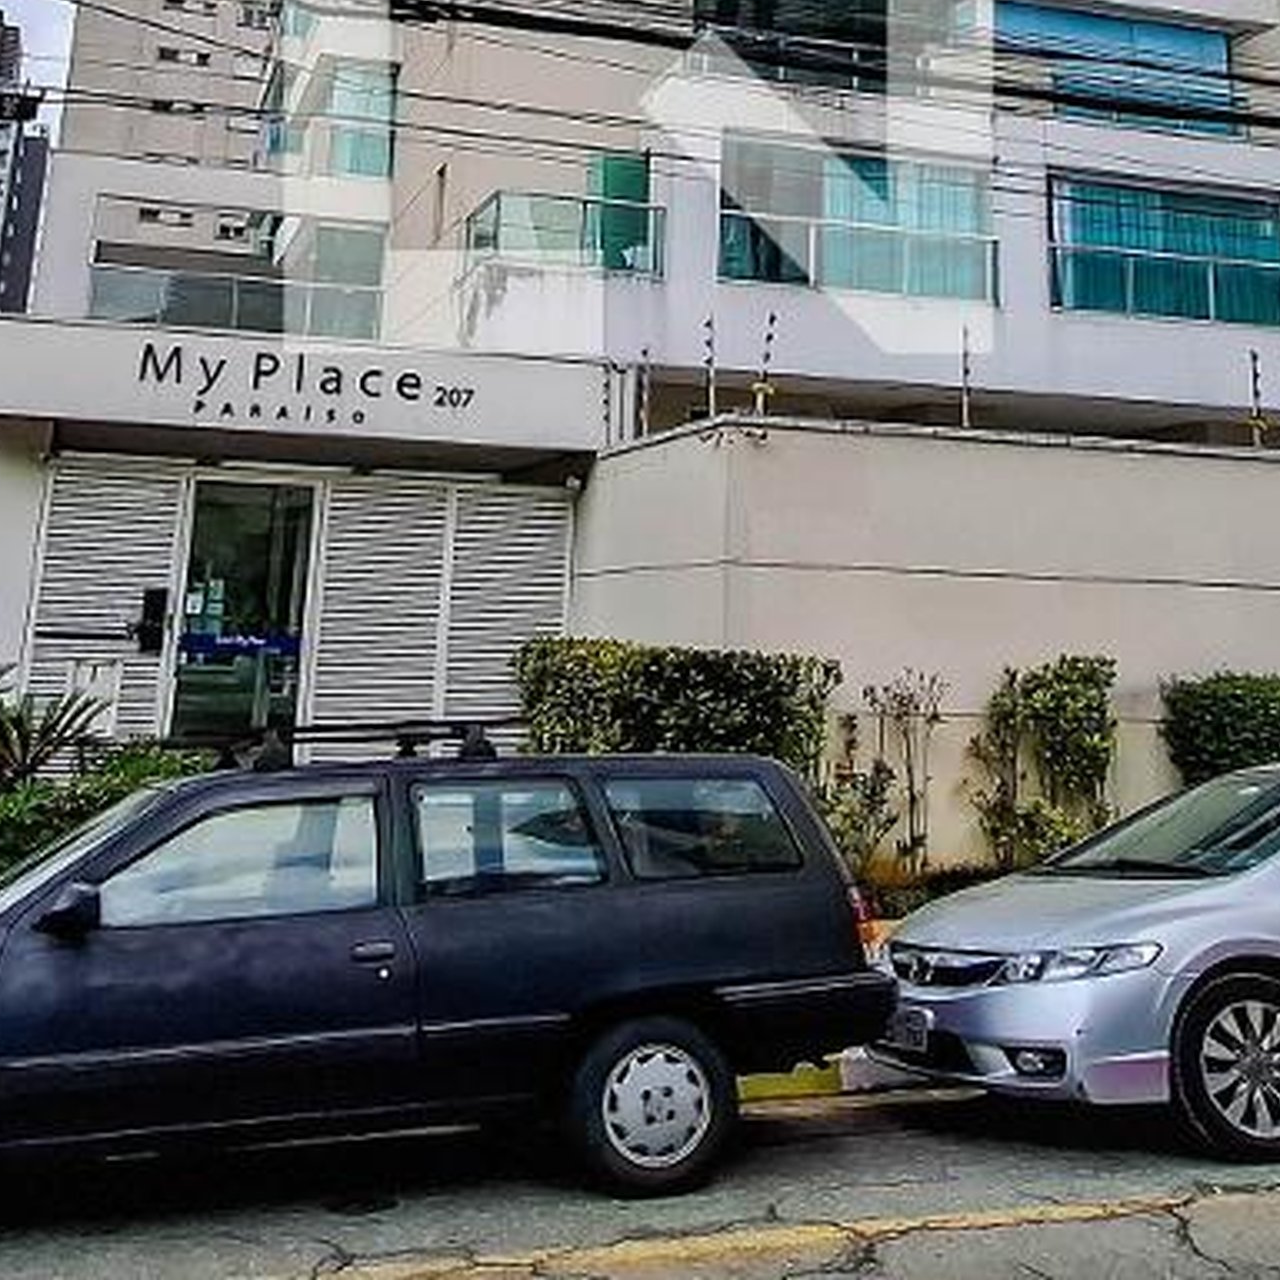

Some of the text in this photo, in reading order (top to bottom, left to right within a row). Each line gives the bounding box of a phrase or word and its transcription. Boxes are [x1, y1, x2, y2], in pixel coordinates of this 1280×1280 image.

[138, 342, 476, 410] My Place 207
